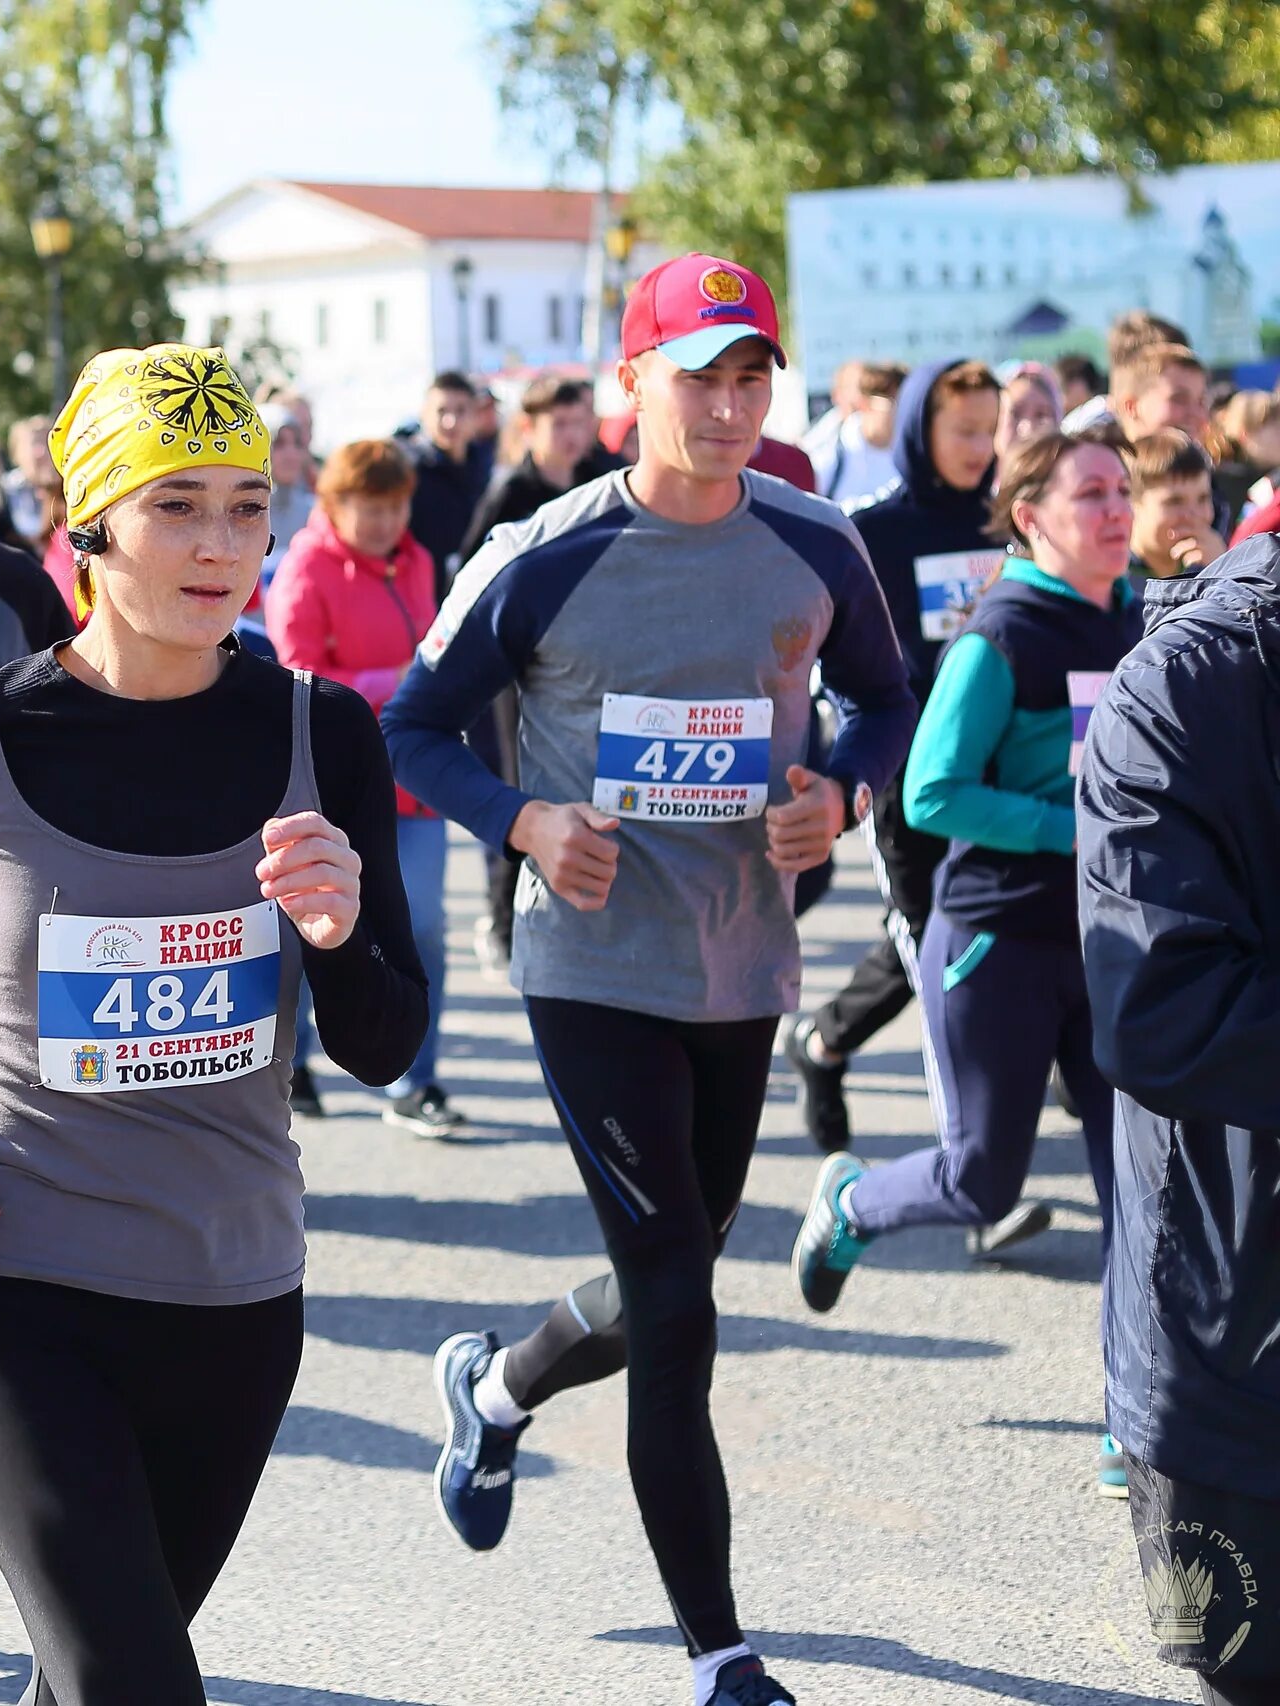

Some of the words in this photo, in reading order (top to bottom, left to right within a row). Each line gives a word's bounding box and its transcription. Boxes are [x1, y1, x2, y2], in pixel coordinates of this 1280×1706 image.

[688, 706, 744, 720] КРОСС
[686, 722, 743, 737] НАЦИИ
[634, 740, 736, 782] 479
[648, 787, 665, 799] 21
[671, 786, 749, 800] СЕНТЯБРЯ
[647, 802, 747, 817] ТОБОЛЬСК
[160, 916, 243, 943] КРОСС
[159, 938, 243, 965] НАЦИИ
[92, 969, 234, 1033] 484
[116, 1044, 140, 1060] 21
[149, 1028, 255, 1058] СЕНТЯБРЯ
[116, 1049, 253, 1085] ТОБОЛЬСК
